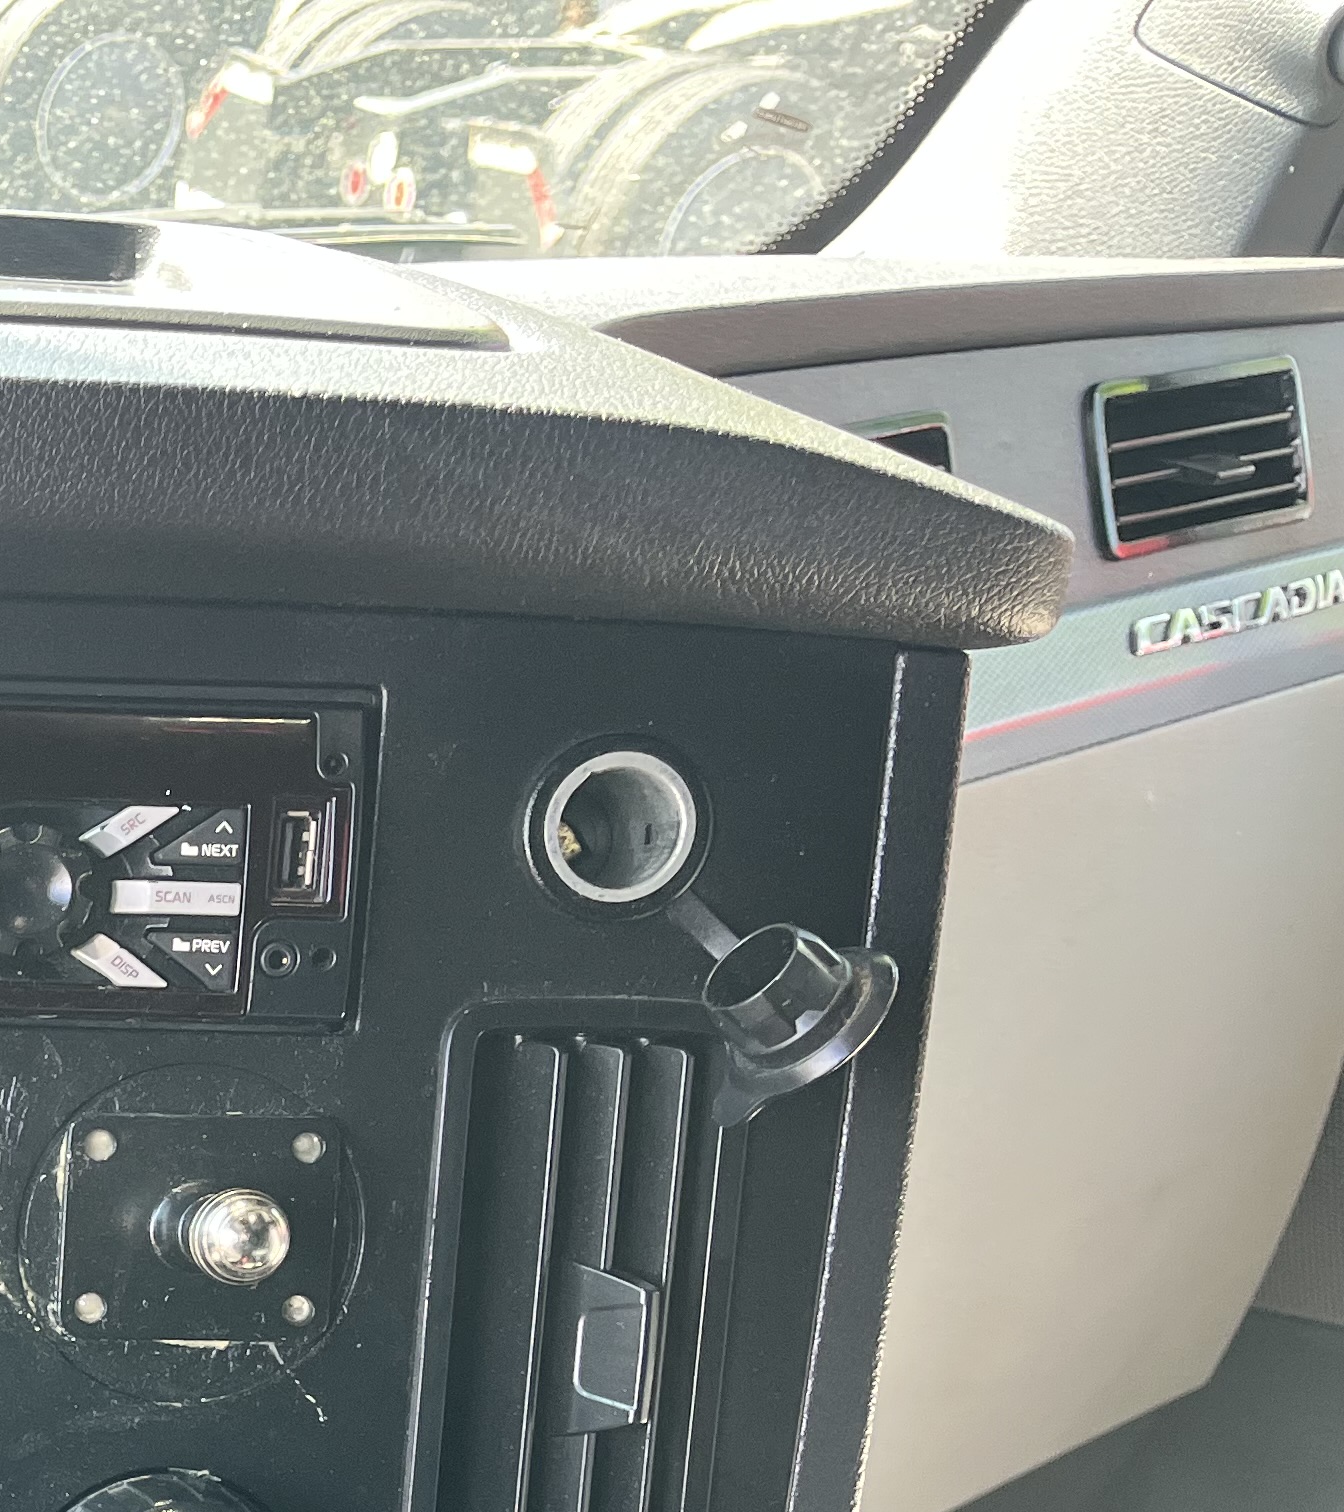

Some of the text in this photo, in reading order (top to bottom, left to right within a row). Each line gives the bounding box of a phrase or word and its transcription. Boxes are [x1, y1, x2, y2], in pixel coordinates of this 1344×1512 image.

[1129, 569, 1344, 656] CASCADIA
[120, 812, 147, 836] SRC
[200, 843, 239, 858] NEXT
[155, 891, 192, 904] SCAN
[191, 938, 231, 954] PREV
[111, 954, 140, 980] DISP
